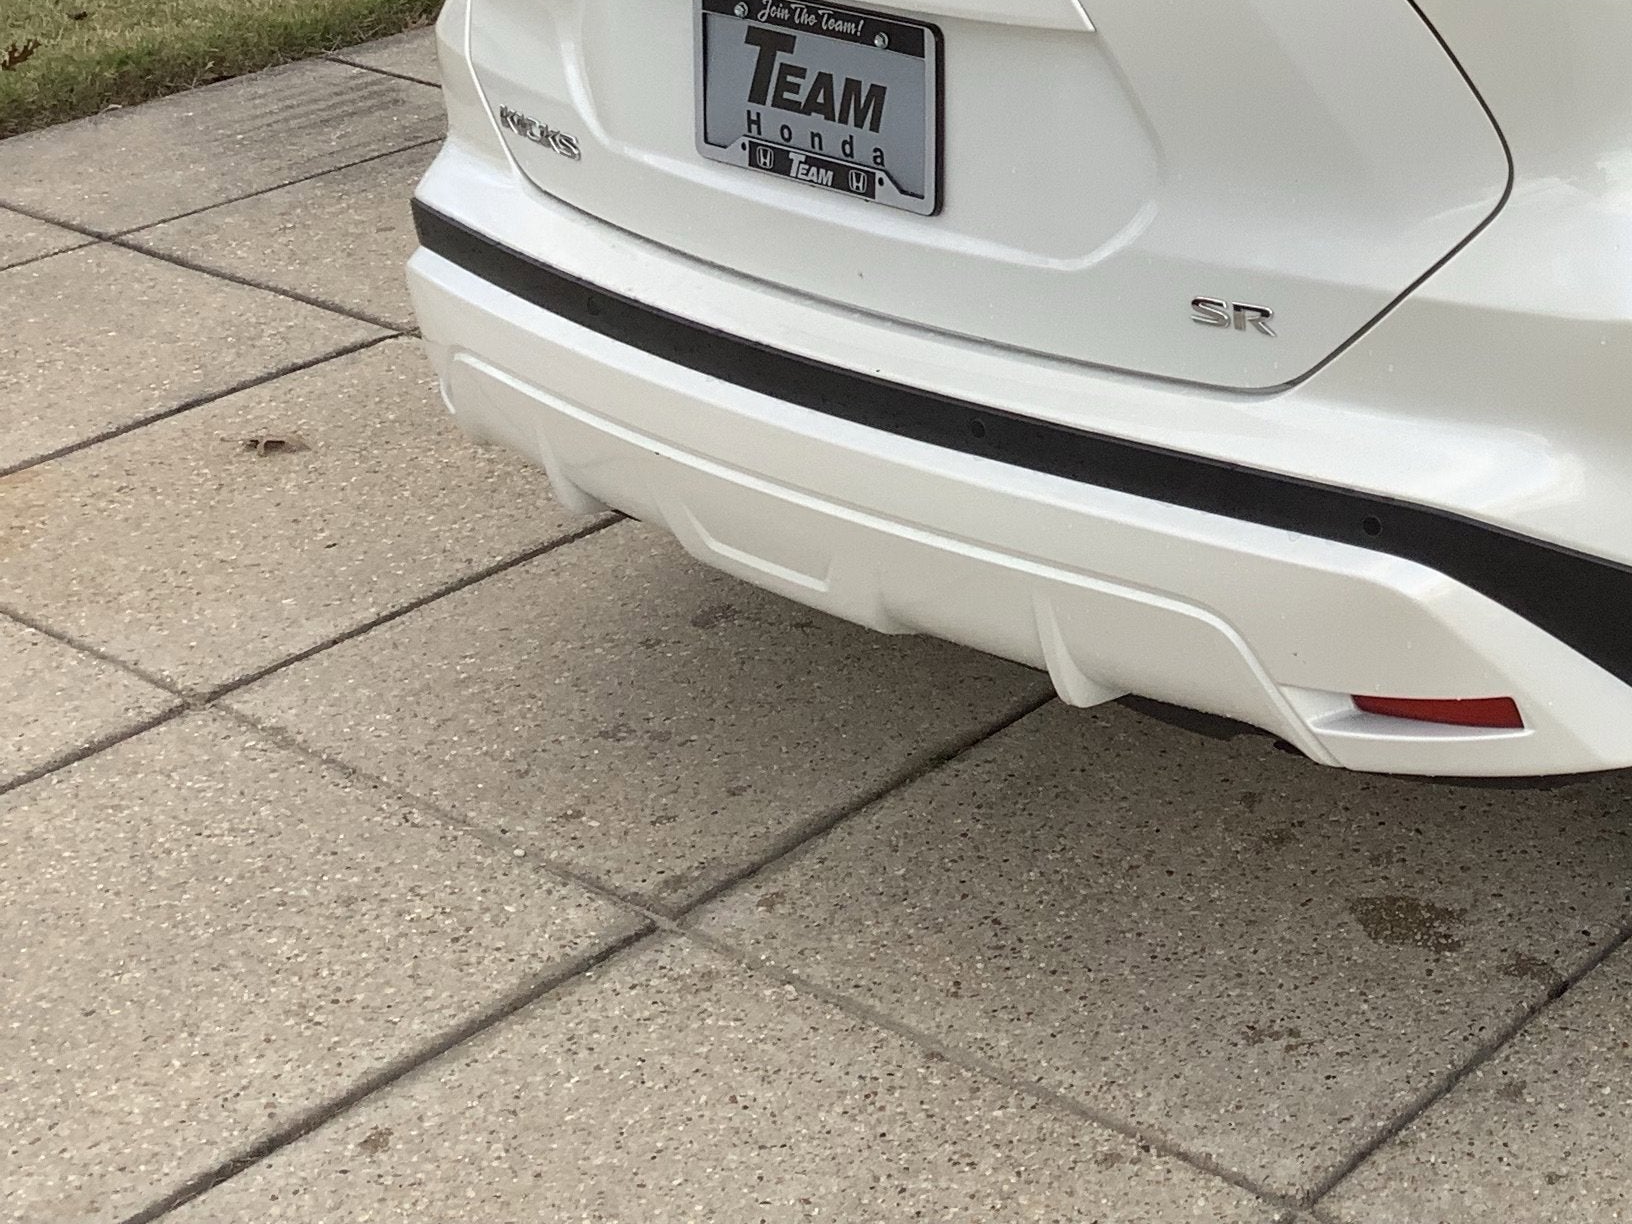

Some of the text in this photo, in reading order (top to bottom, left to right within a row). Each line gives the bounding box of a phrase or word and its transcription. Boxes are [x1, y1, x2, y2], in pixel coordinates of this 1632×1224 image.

[790, 2, 818, 26] The
[818, 9, 865, 36] Team!
[744, 25, 888, 134] TEAM
[499, 104, 582, 162] KICKS
[746, 109, 887, 168] Honda
[788, 151, 834, 187] TEAM
[1190, 295, 1277, 338] SR
